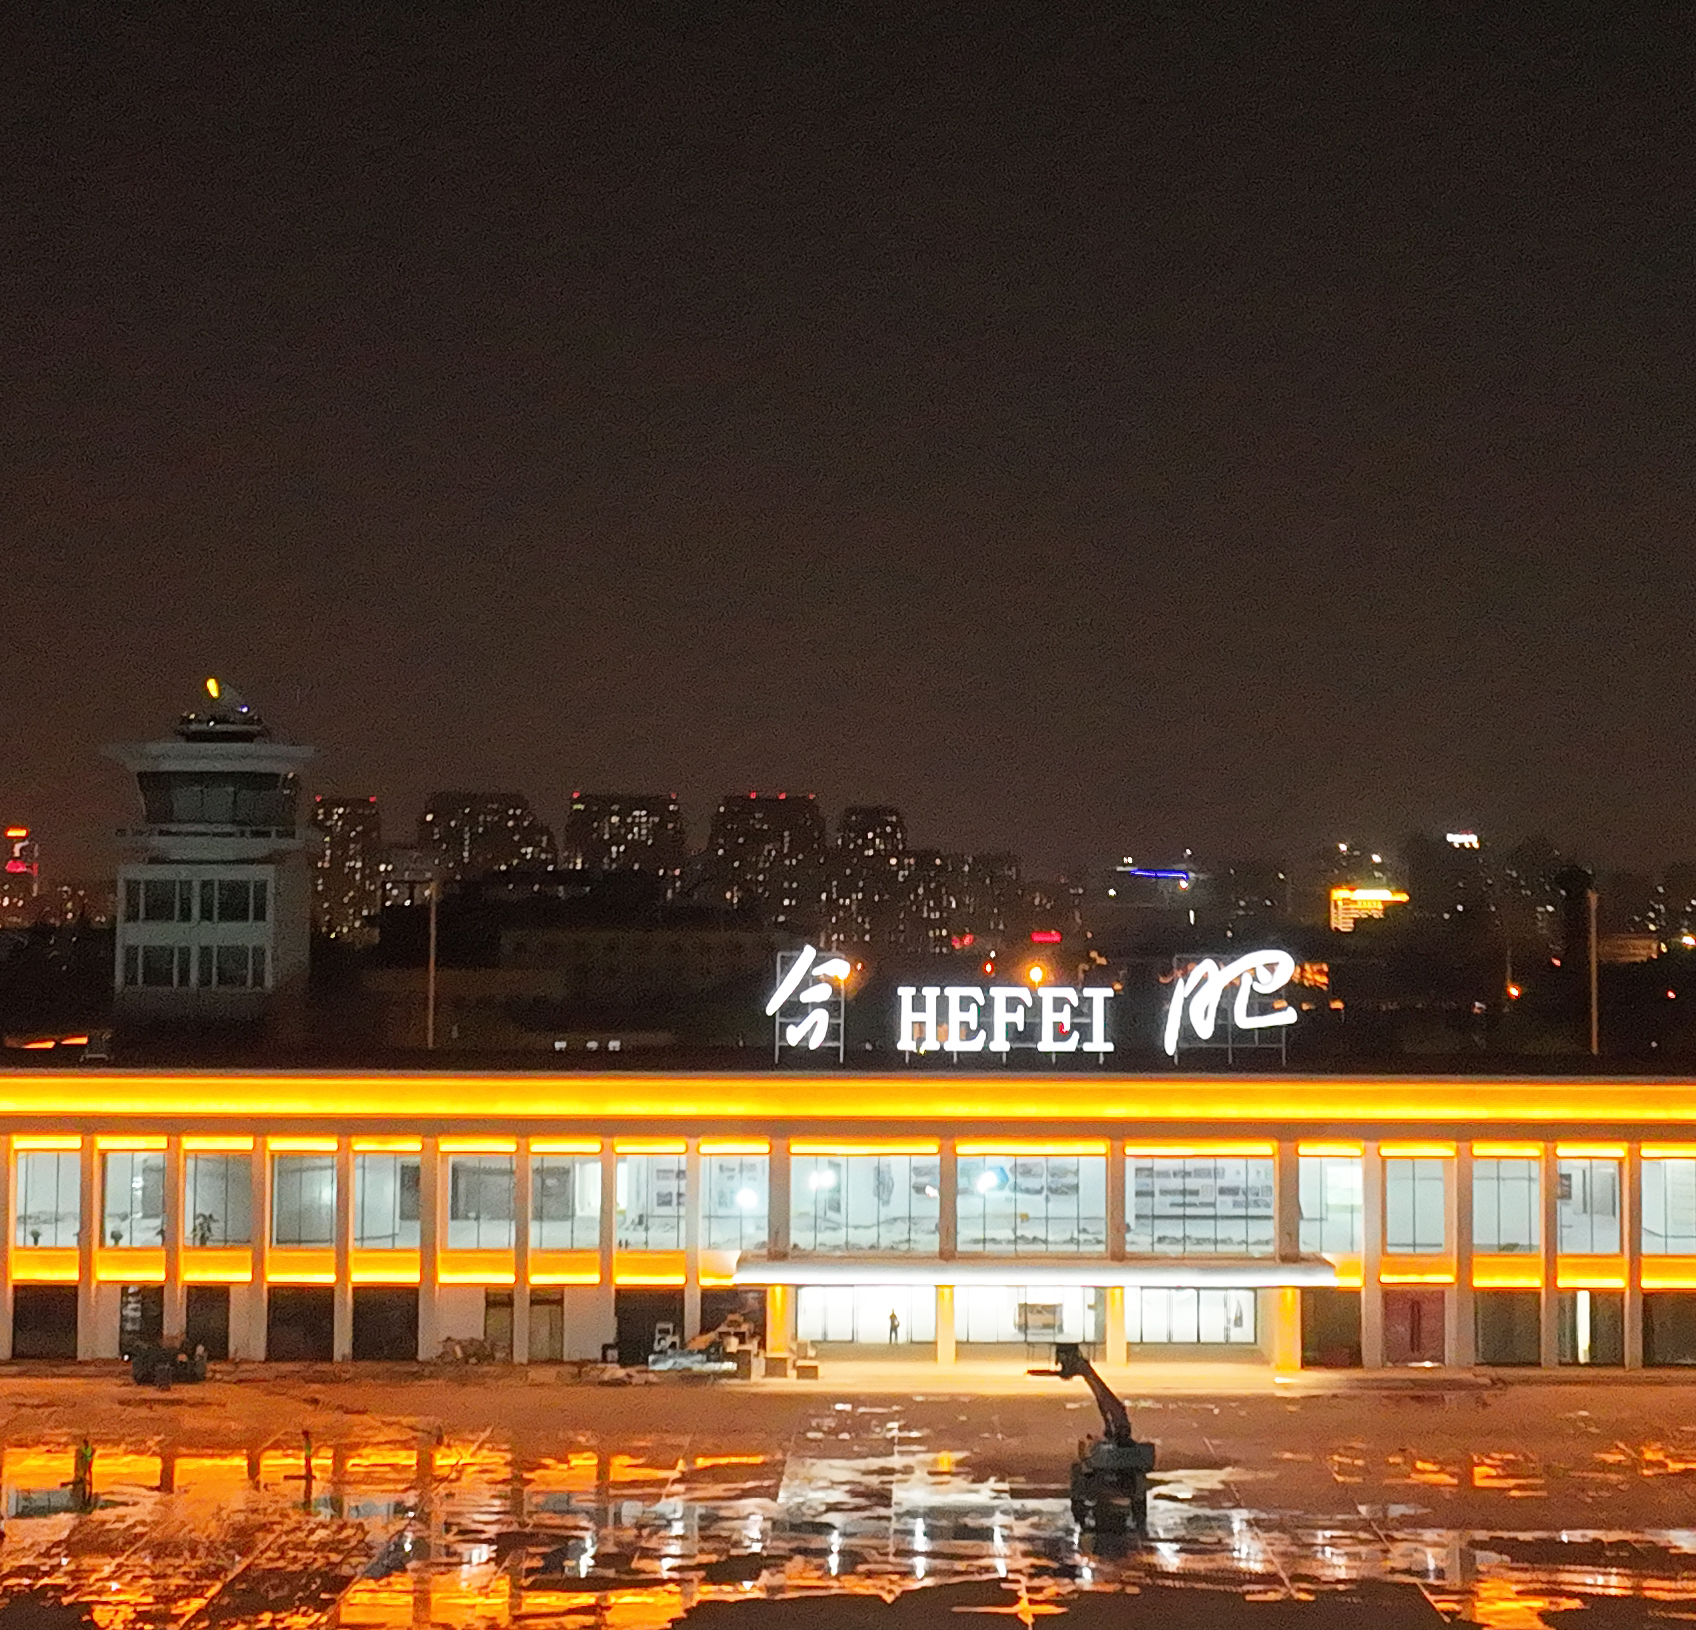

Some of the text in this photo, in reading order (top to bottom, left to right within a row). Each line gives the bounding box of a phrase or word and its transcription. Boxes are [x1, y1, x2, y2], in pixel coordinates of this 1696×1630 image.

[765, 944, 1298, 1056] 合 HEFEI 肥
